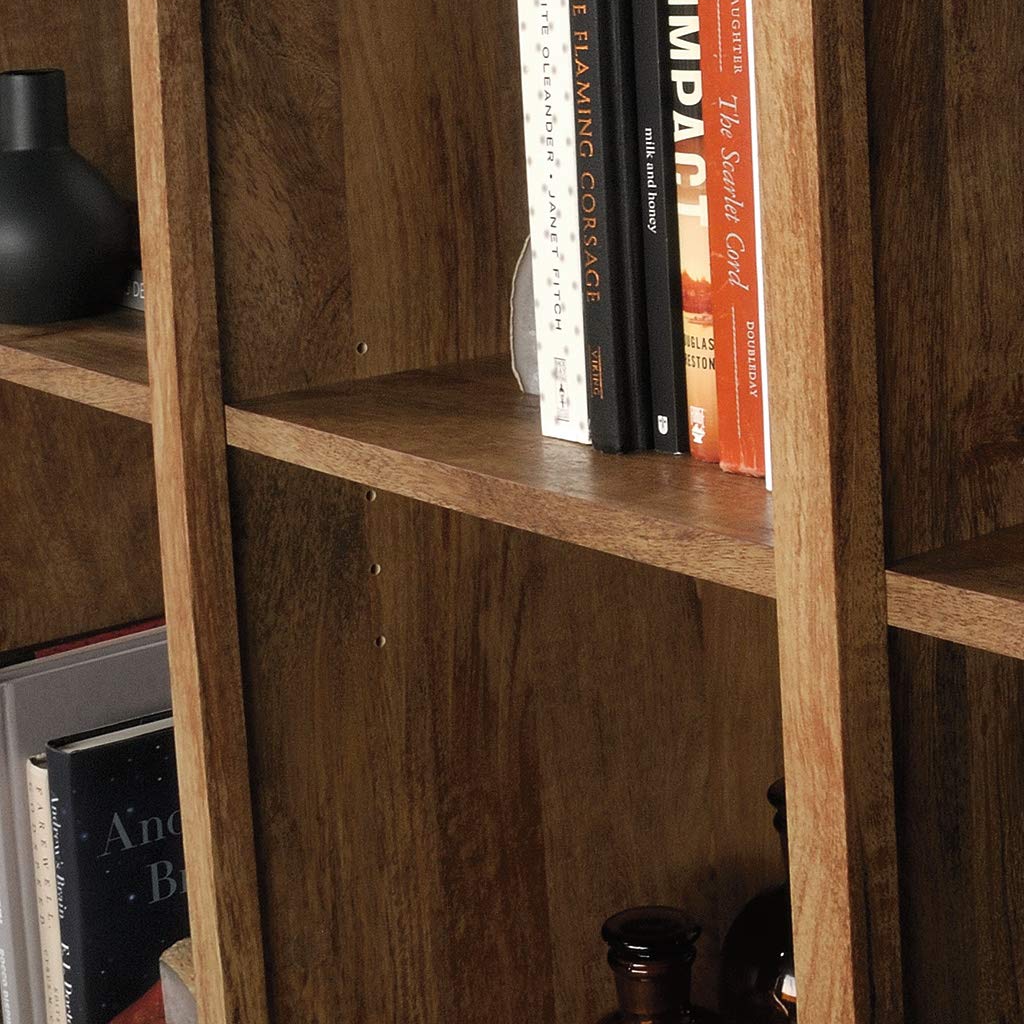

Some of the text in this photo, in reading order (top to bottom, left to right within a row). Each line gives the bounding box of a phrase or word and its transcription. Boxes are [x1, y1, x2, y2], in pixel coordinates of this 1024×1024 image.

[541, 46, 555, 162] OLEANDER
[574, 31, 594, 158] FLAMING
[548, 190, 559, 257] JANET
[644, 127, 658, 234] milk and honey
[718, 94, 750, 292] The Scarlet Cord
[581, 171, 600, 304] CORSAGE
[552, 268, 562, 331] FITCH
[591, 349, 601, 396] VIKING
[746, 321, 758, 398] DOUBLEDAY
